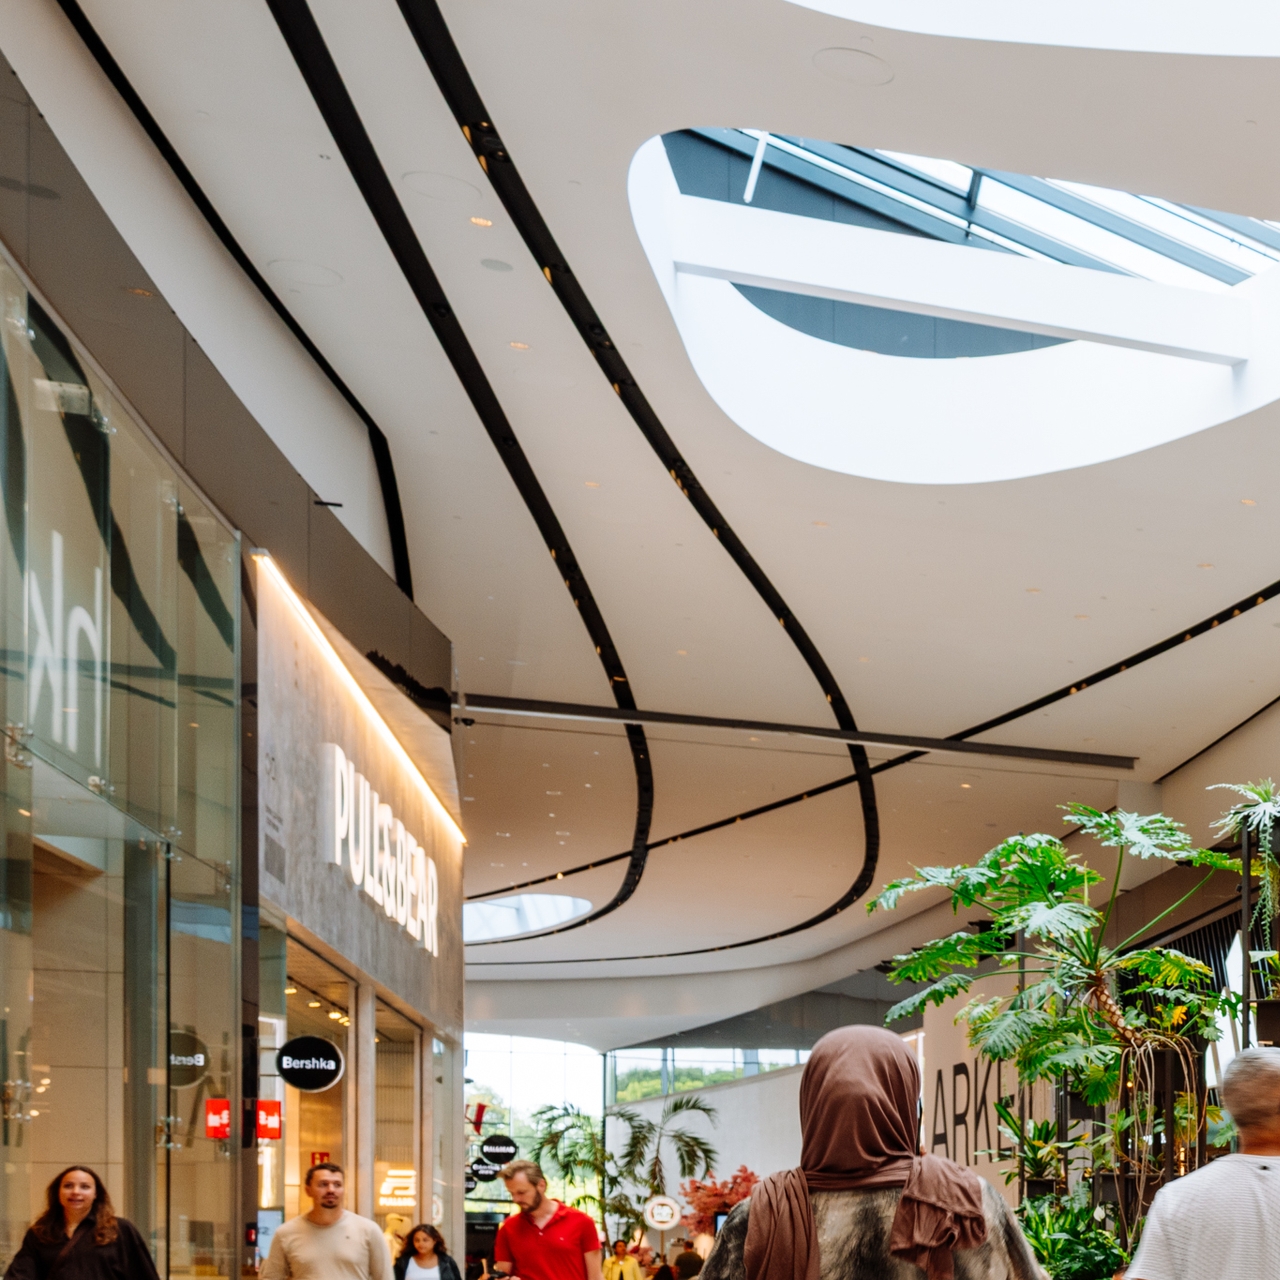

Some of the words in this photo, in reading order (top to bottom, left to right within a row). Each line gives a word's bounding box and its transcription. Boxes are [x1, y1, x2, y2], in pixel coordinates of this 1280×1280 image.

[330, 743, 438, 958] PULL&BEAR
[282, 1055, 336, 1070] Bershka
[931, 1057, 1032, 1167] ARKE
